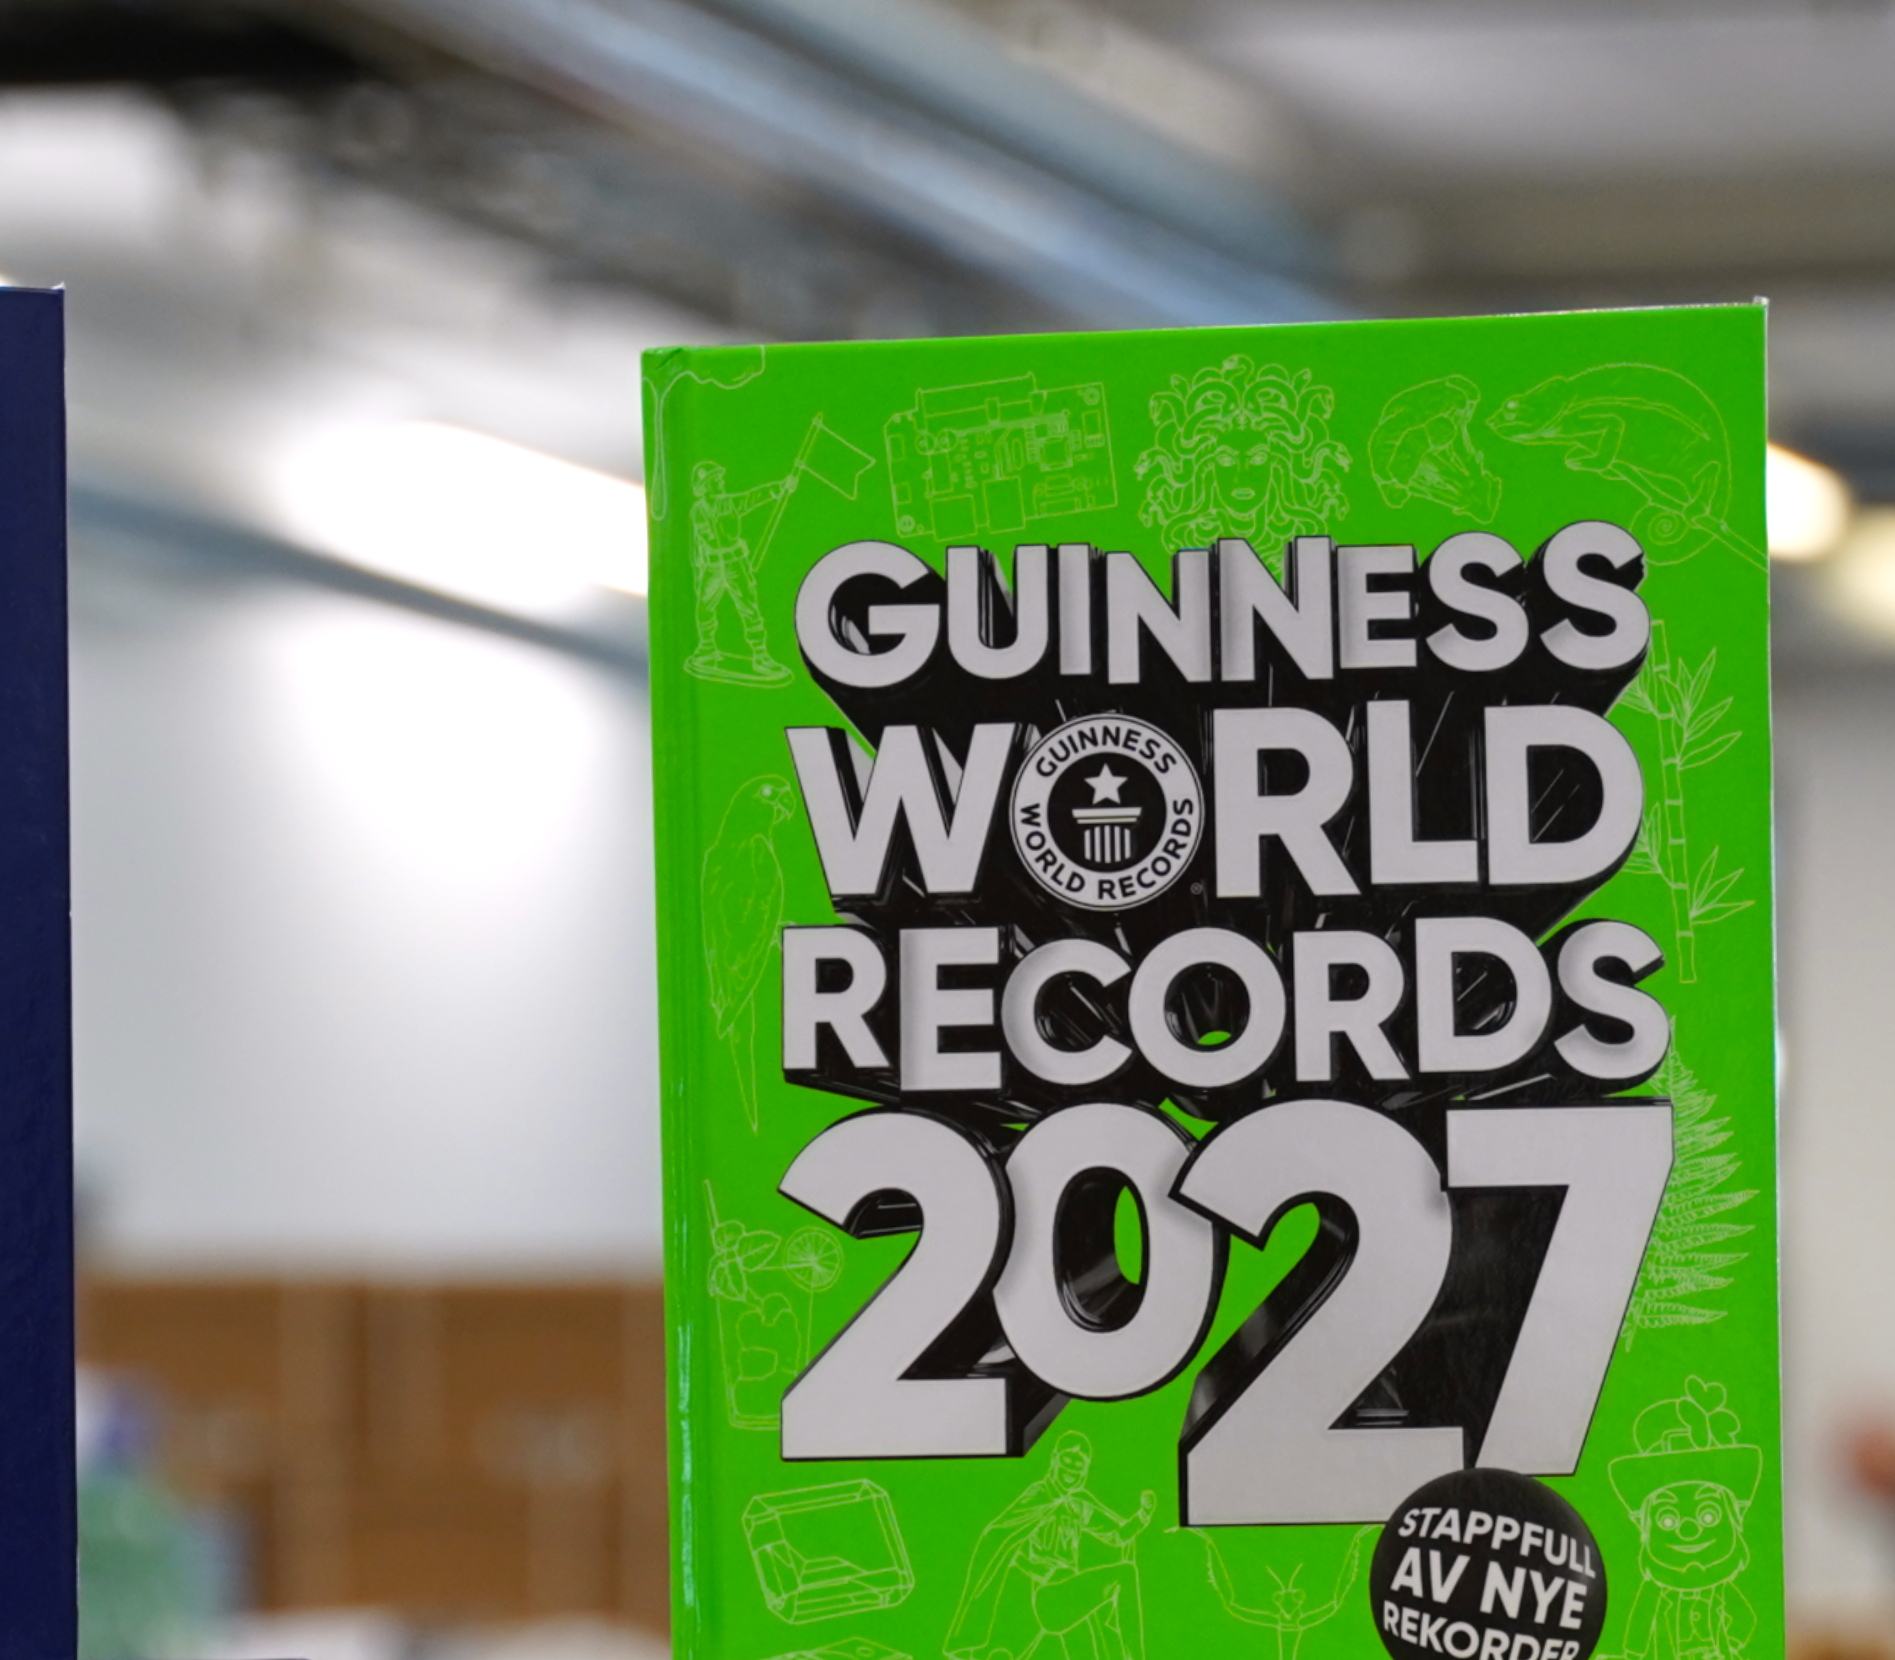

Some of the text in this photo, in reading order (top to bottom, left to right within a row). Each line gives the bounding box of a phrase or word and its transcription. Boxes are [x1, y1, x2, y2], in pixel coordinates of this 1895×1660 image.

[794, 520, 1651, 689] GUINNESS
[1035, 724, 1177, 779] GUINNESS
[1019, 797, 1195, 900] WORLD RECORDS
[782, 917, 1671, 1091] RECORDS
[776, 1098, 1676, 1528] 2027
[1390, 1546, 1588, 1630] AV NYE
[1398, 1507, 1596, 1579] STAPPFULL
